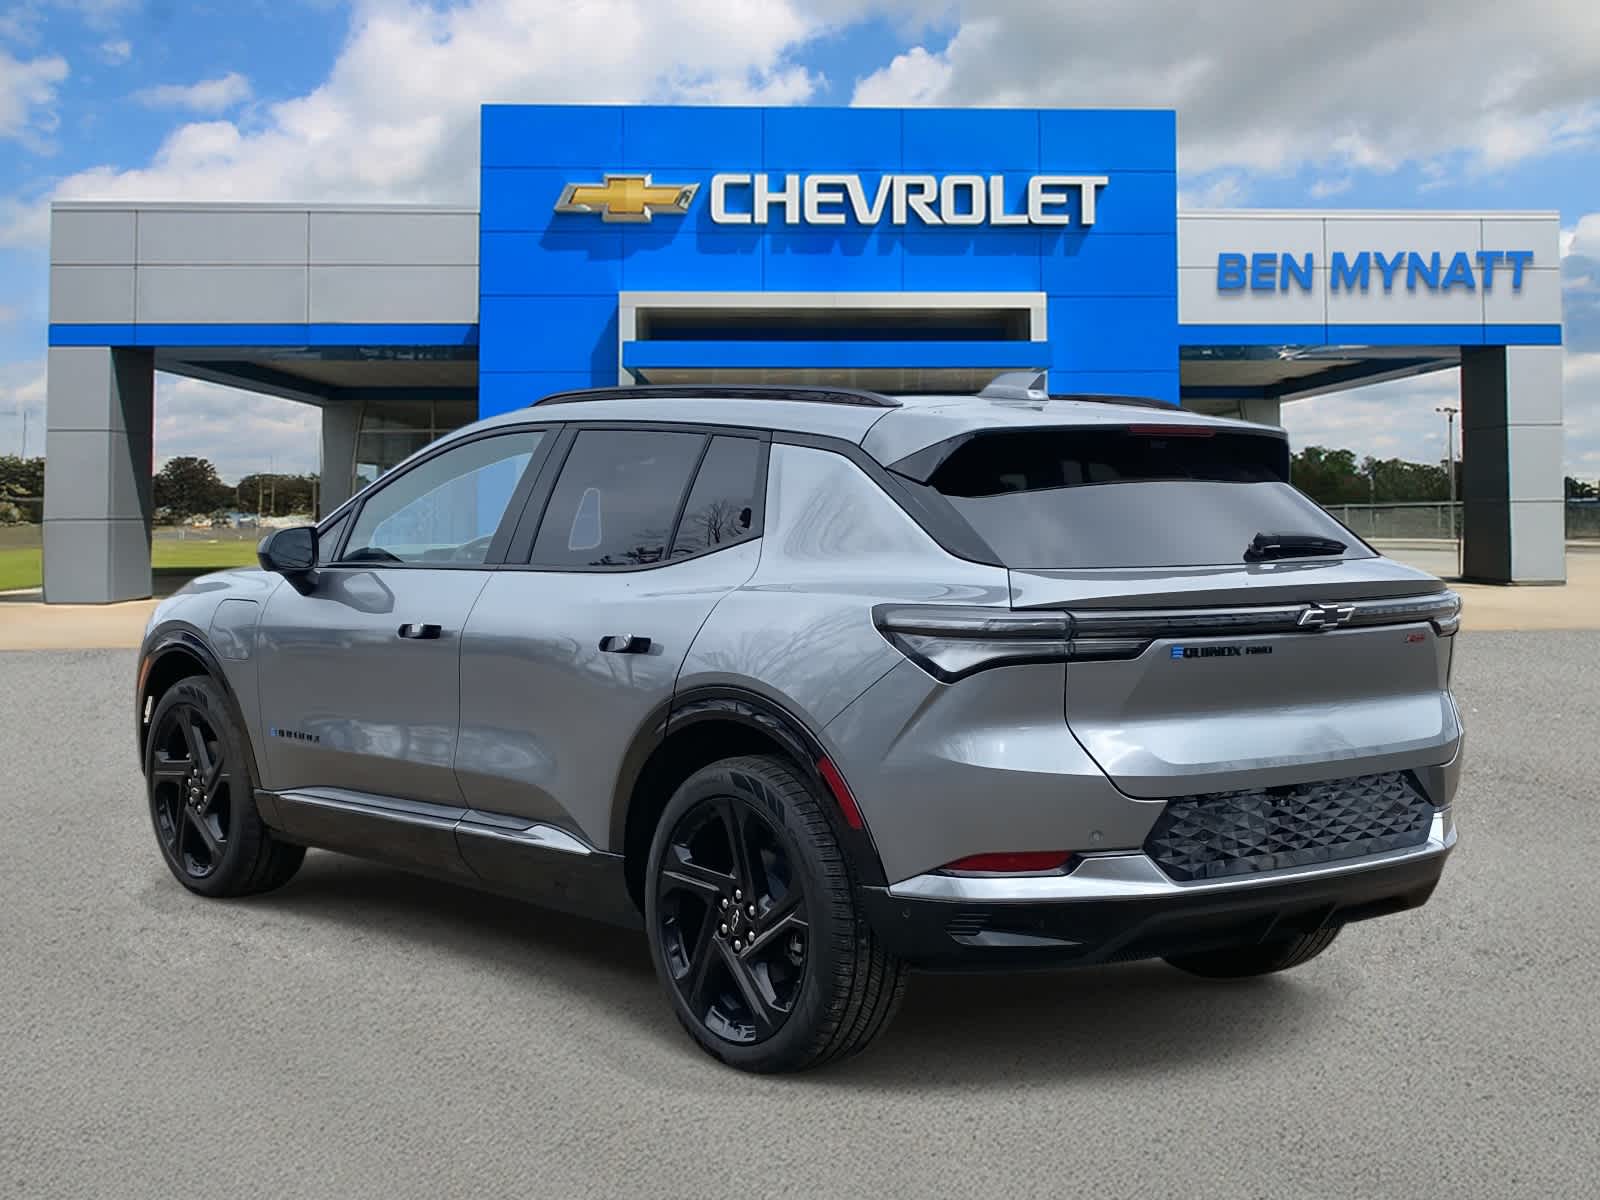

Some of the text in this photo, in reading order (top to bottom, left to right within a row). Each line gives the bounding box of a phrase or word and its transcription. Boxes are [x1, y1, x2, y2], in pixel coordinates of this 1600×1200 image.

[710, 173, 1109, 225] CHEVROLET
[1217, 250, 1534, 291] BEN MYNATT
[1170, 646, 1241, 658] EQUINOX
